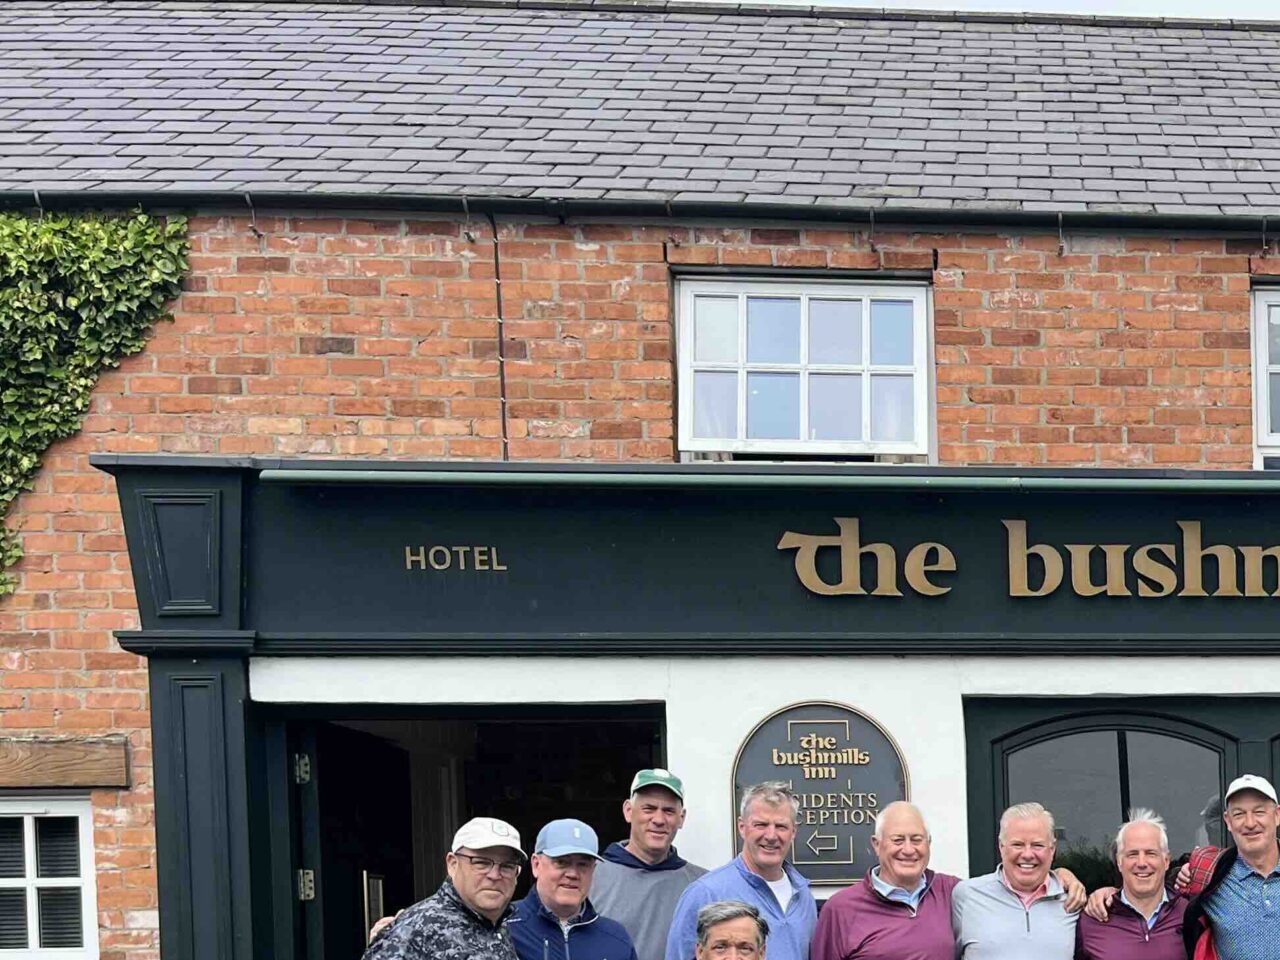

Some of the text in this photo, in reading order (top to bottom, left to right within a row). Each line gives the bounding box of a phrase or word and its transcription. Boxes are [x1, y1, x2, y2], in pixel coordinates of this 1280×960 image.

[404, 545, 508, 570] HOTEL
[777, 517, 956, 596] the
[800, 733, 837, 749] the
[772, 748, 870, 765] bushmills
[803, 764, 836, 779] inn
[793, 793, 877, 808] SIDENTS
[796, 809, 879, 825] CEPTION
